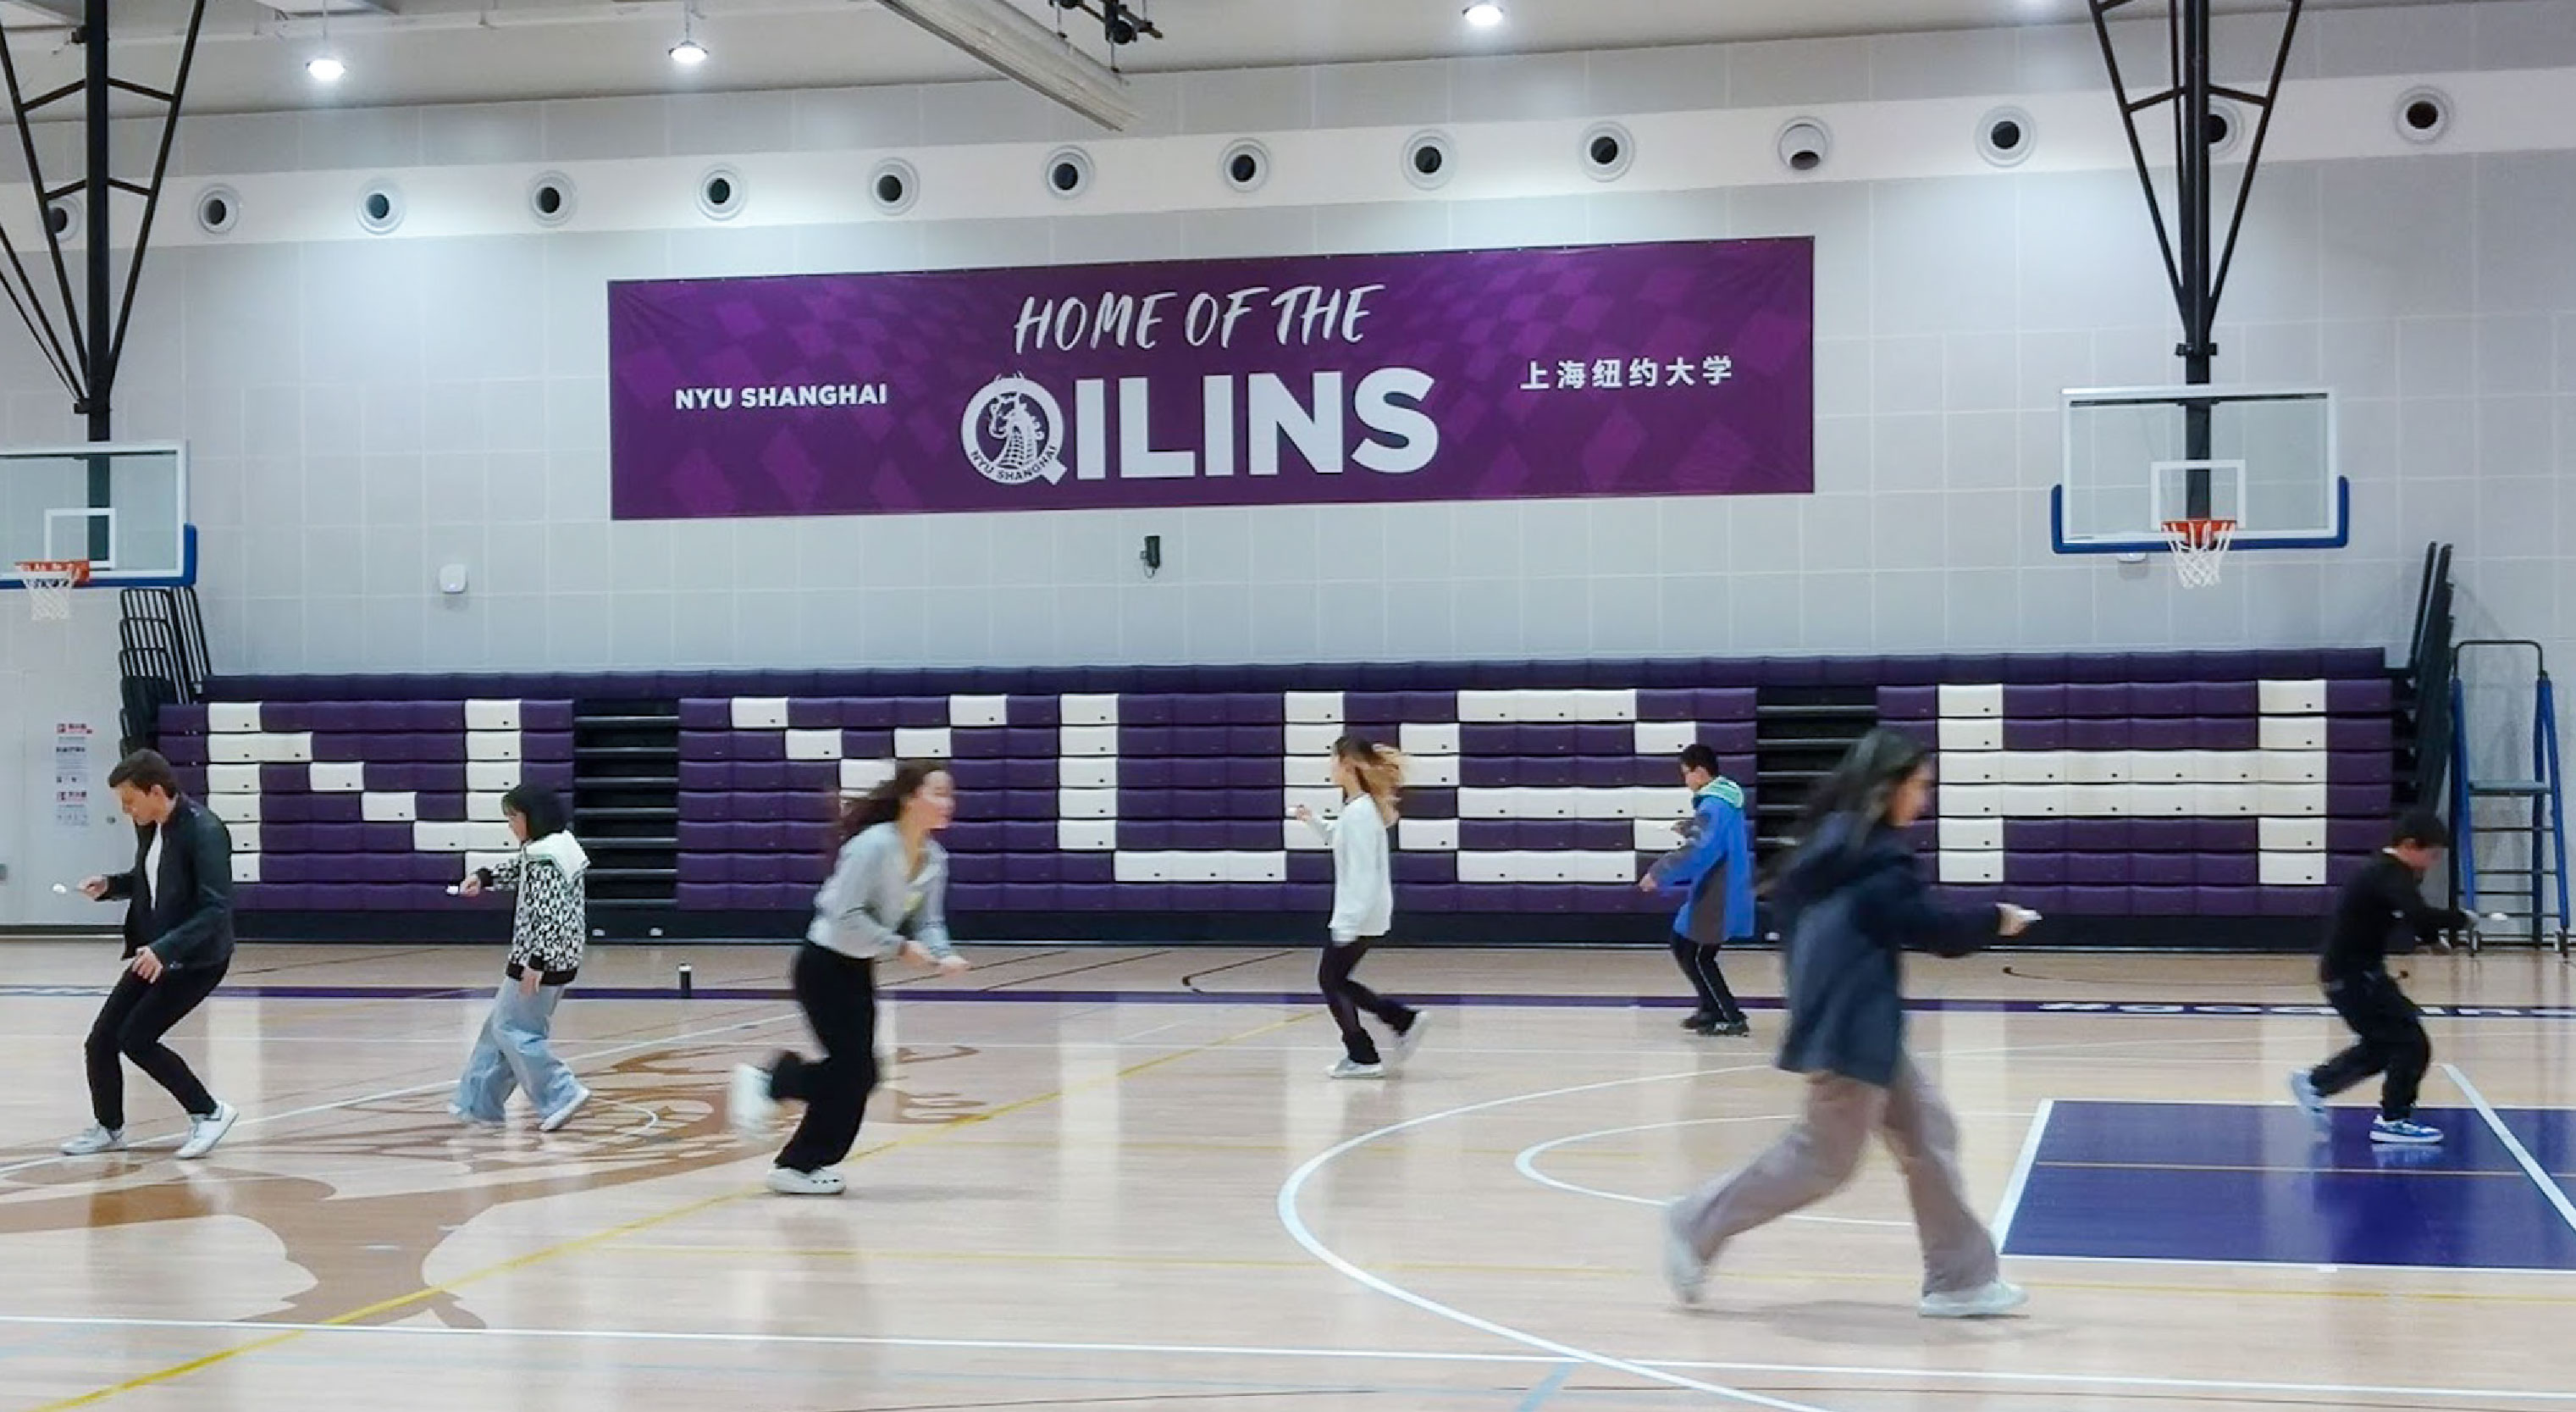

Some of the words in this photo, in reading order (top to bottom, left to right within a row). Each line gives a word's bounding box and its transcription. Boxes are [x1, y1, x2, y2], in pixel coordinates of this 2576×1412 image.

[1014, 292, 1177, 353] HOME
[1186, 287, 1269, 348] OF
[1270, 284, 1385, 346] THE
[1520, 356, 1732, 390] 上海纽约大学
[675, 388, 732, 409] NYU
[742, 383, 887, 408] SHANGHAI
[961, 368, 1440, 485] QILINS
[970, 450, 994, 474] NYU
[997, 444, 1058, 480] SHANGHAI
